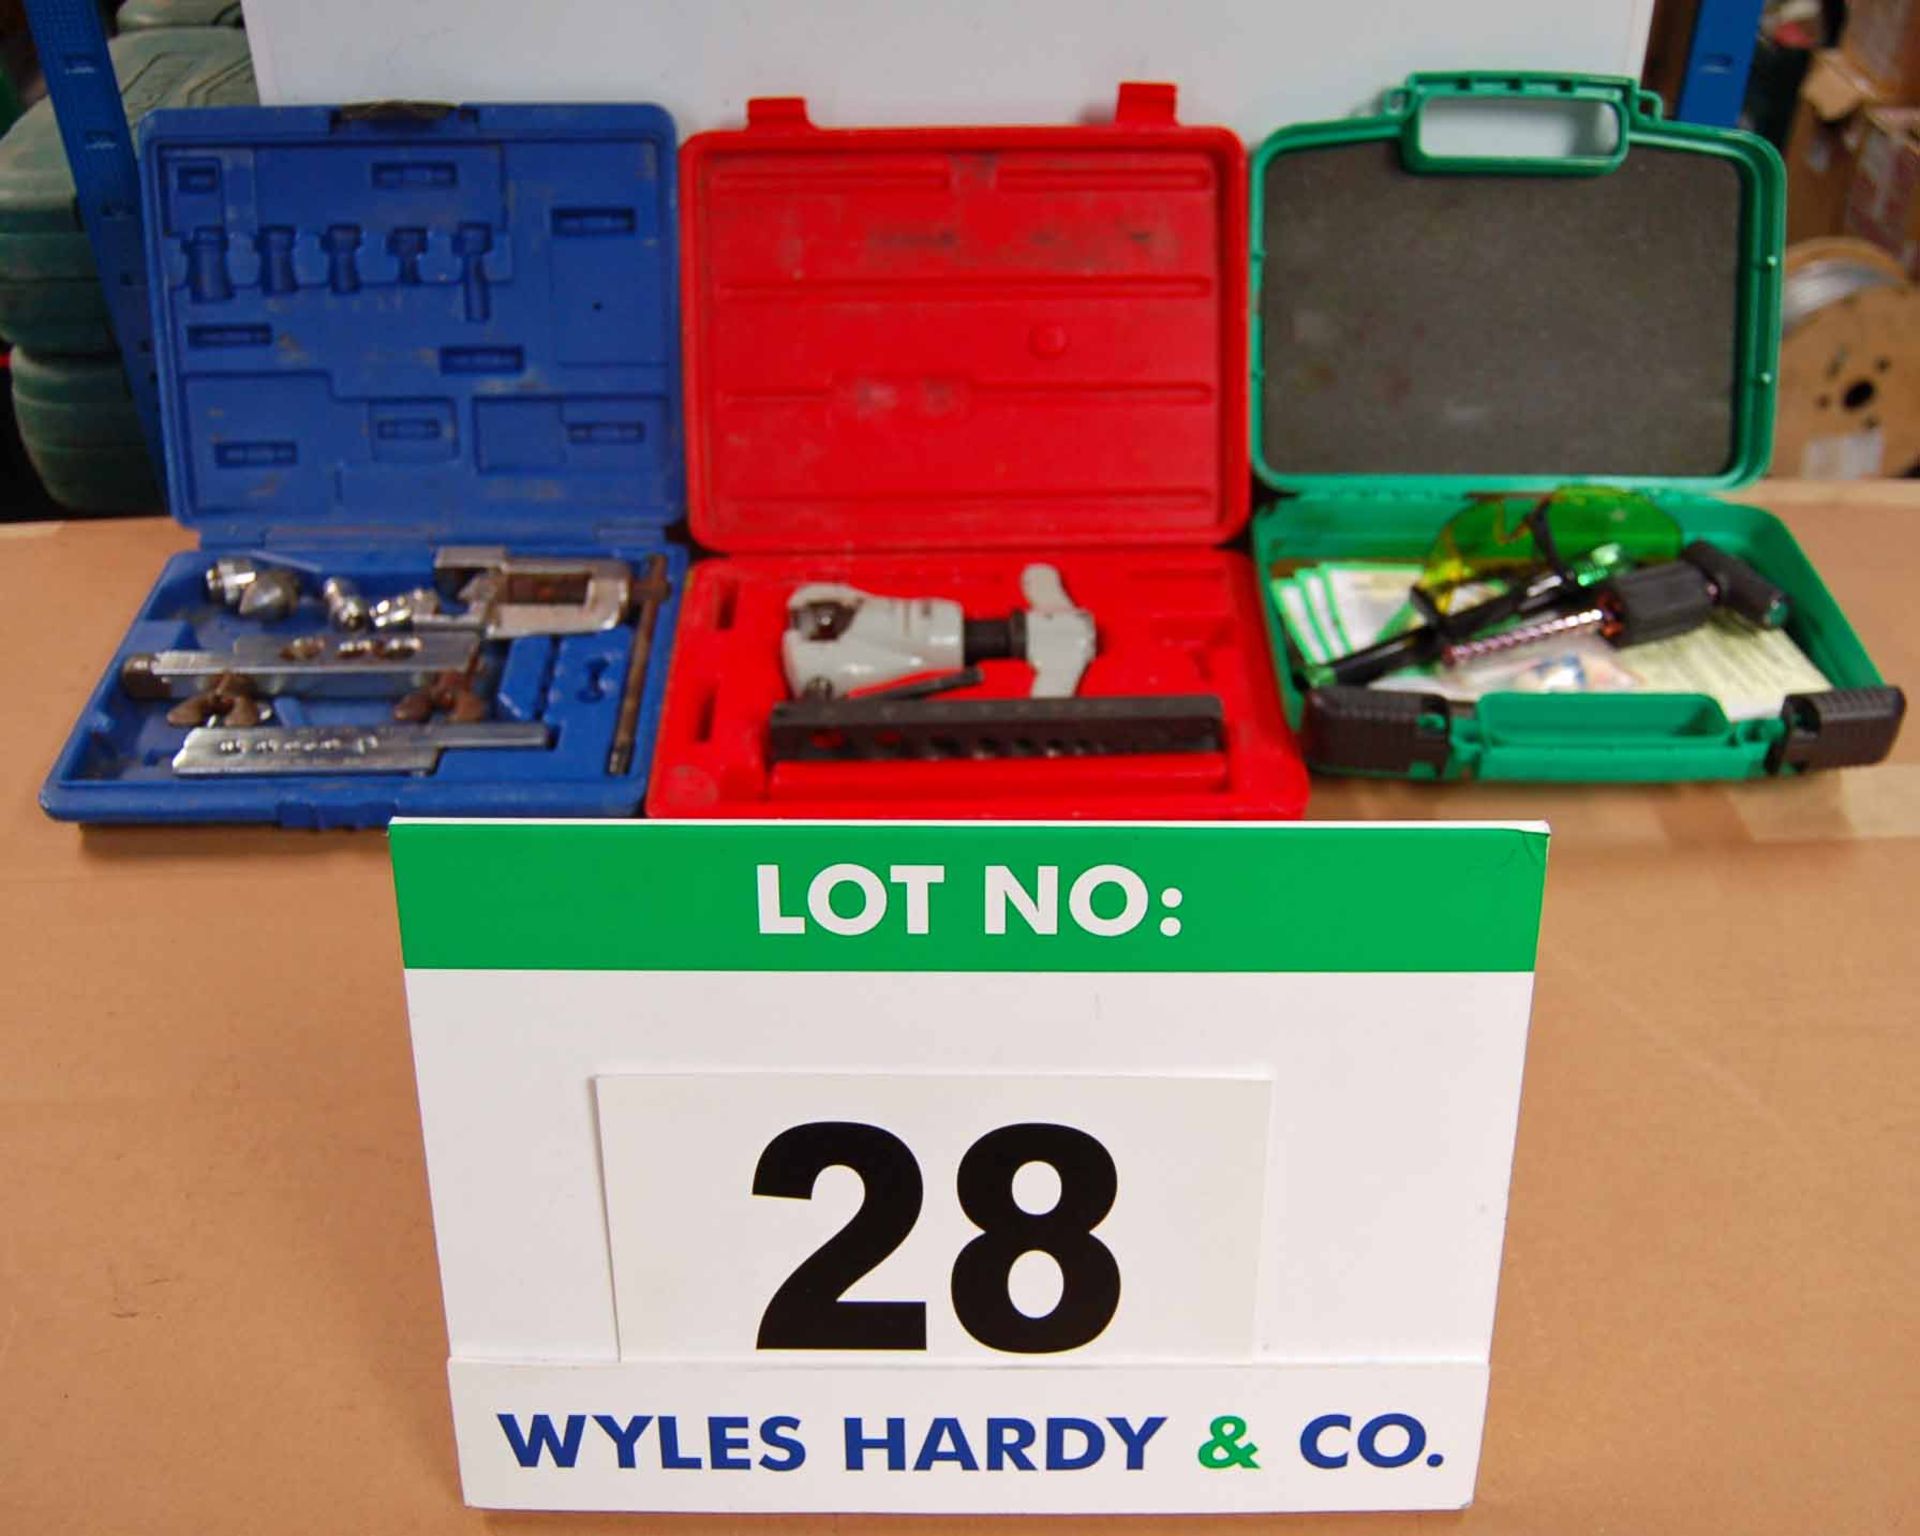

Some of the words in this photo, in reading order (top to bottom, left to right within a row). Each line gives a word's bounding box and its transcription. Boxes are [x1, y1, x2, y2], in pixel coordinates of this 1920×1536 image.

[757, 863, 945, 936] LOT
[984, 864, 1184, 938] NO:
[751, 1121, 1122, 1355] 28
[496, 1413, 807, 1472] WYLES
[844, 1416, 1168, 1471] HARDY
[1197, 1415, 1261, 1470] &
[1299, 1413, 1445, 1470] CO.
